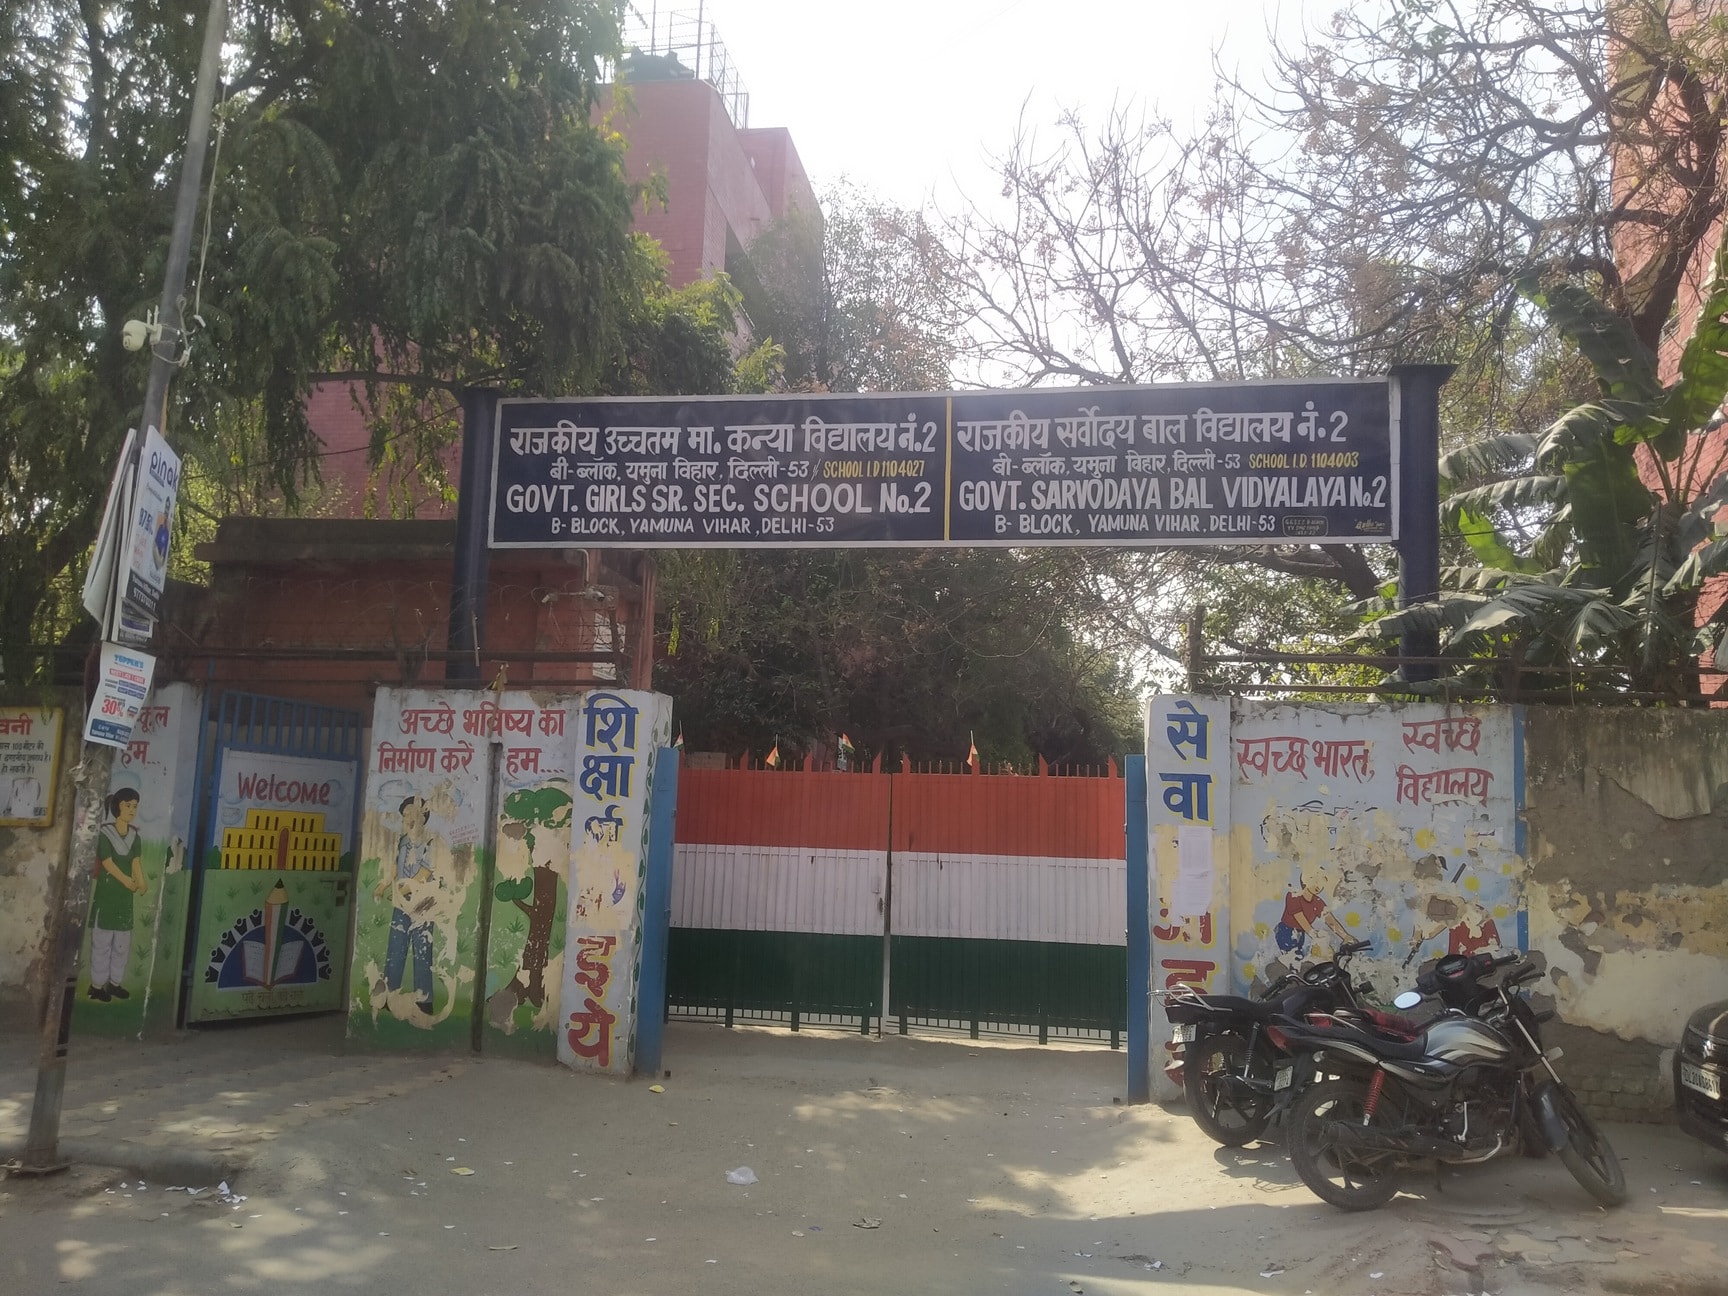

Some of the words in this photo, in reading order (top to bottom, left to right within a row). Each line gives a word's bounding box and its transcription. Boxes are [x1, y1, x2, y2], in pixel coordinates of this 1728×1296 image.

[510, 420, 600, 455] राजकीय
[604, 426, 682, 455] उच्चतम
[687, 426, 721, 454] मा.
[725, 424, 795, 452] कन्या
[801, 416, 897, 452] विद्यालय
[957, 409, 1051, 452] राजकीय
[1054, 405, 1137, 449] सर्वोदय
[1142, 415, 1189, 444] बाल
[1193, 407, 1294, 443] विद्यालय
[625, 462, 668, 484] यमुना
[823, 459, 864, 479] SCHOOL
[881, 460, 926, 478] 1104027
[1071, 456, 1118, 479] यमुना
[1249, 453, 1290, 469] SCHOOL
[1311, 451, 1360, 469] 1104003
[506, 484, 579, 513] GOVT.
[586, 484, 647, 513] GIRLS
[652, 484, 688, 513] SR.
[693, 483, 745, 513] SEC.
[753, 482, 872, 513] SCHOOL
[959, 480, 1027, 511] GOVT.
[1031, 477, 1162, 511] SARVODAYA
[1170, 476, 1214, 509] BAL
[1222, 475, 1347, 508] VIDYALAYA
[630, 517, 694, 534] YAMUNA
[762, 516, 835, 534] DELHI-53
[1088, 513, 1149, 533] YAMUNA
[1210, 513, 1276, 532] DELHI-53
[139, 705, 171, 734] कूल
[399, 701, 456, 740] अच्छे
[462, 701, 535, 737] भविष्य
[538, 709, 567, 737] का
[1402, 717, 1482, 756] स्वच्छ
[377, 740, 437, 774] निर्माण
[440, 740, 475, 774] करें
[1236, 736, 1310, 780] स्वच्छ
[238, 771, 331, 806] Welcome
[1395, 764, 1495, 807] विद्यालय
